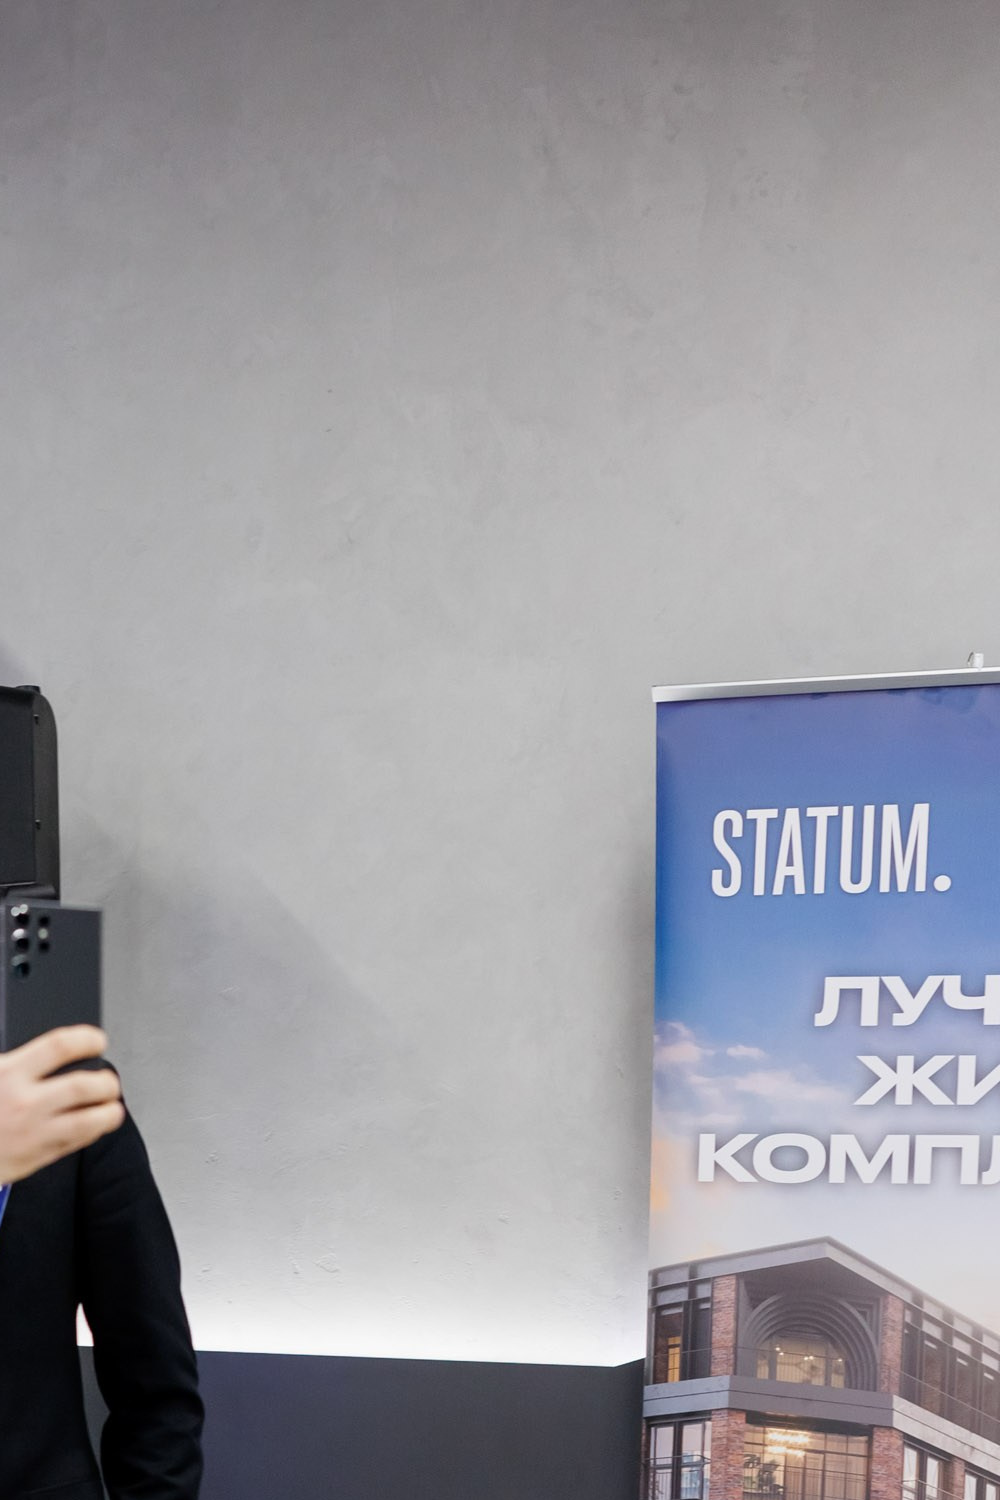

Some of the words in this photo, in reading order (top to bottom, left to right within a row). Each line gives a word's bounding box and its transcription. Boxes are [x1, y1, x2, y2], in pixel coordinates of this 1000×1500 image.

[711, 803, 952, 898] STATUM.
[814, 974, 1000, 1027] ЛУЧ
[697, 1133, 1000, 1185] КОМП
